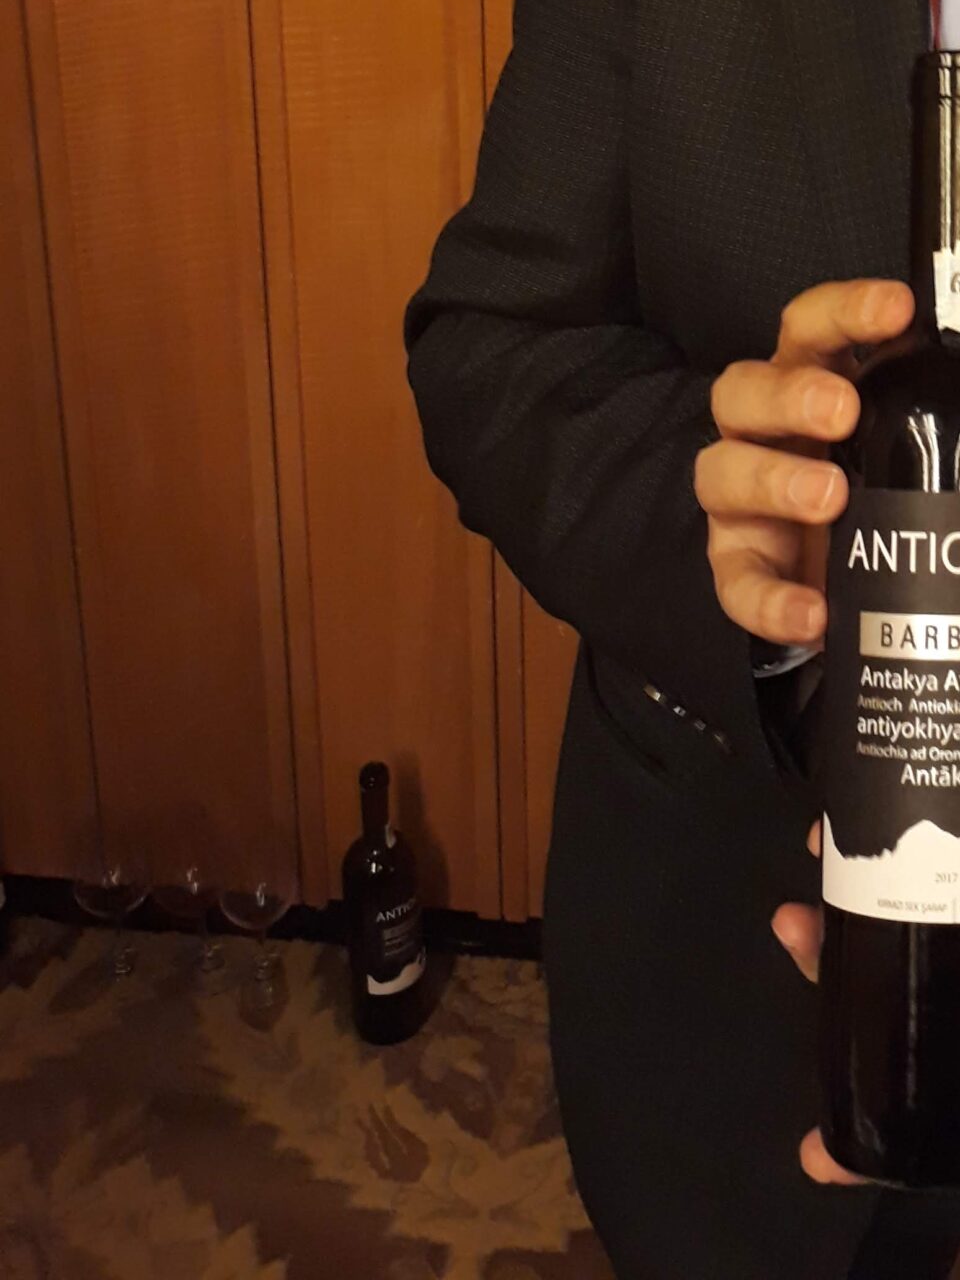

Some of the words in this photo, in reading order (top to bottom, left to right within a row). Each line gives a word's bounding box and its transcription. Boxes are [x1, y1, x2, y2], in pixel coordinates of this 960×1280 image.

[860, 665, 938, 696] Antakya
[857, 695, 903, 713] Antioch
[856, 741, 908, 760] Antiochia
[910, 745, 927, 761] ad
[935, 871, 958, 884] 2017
